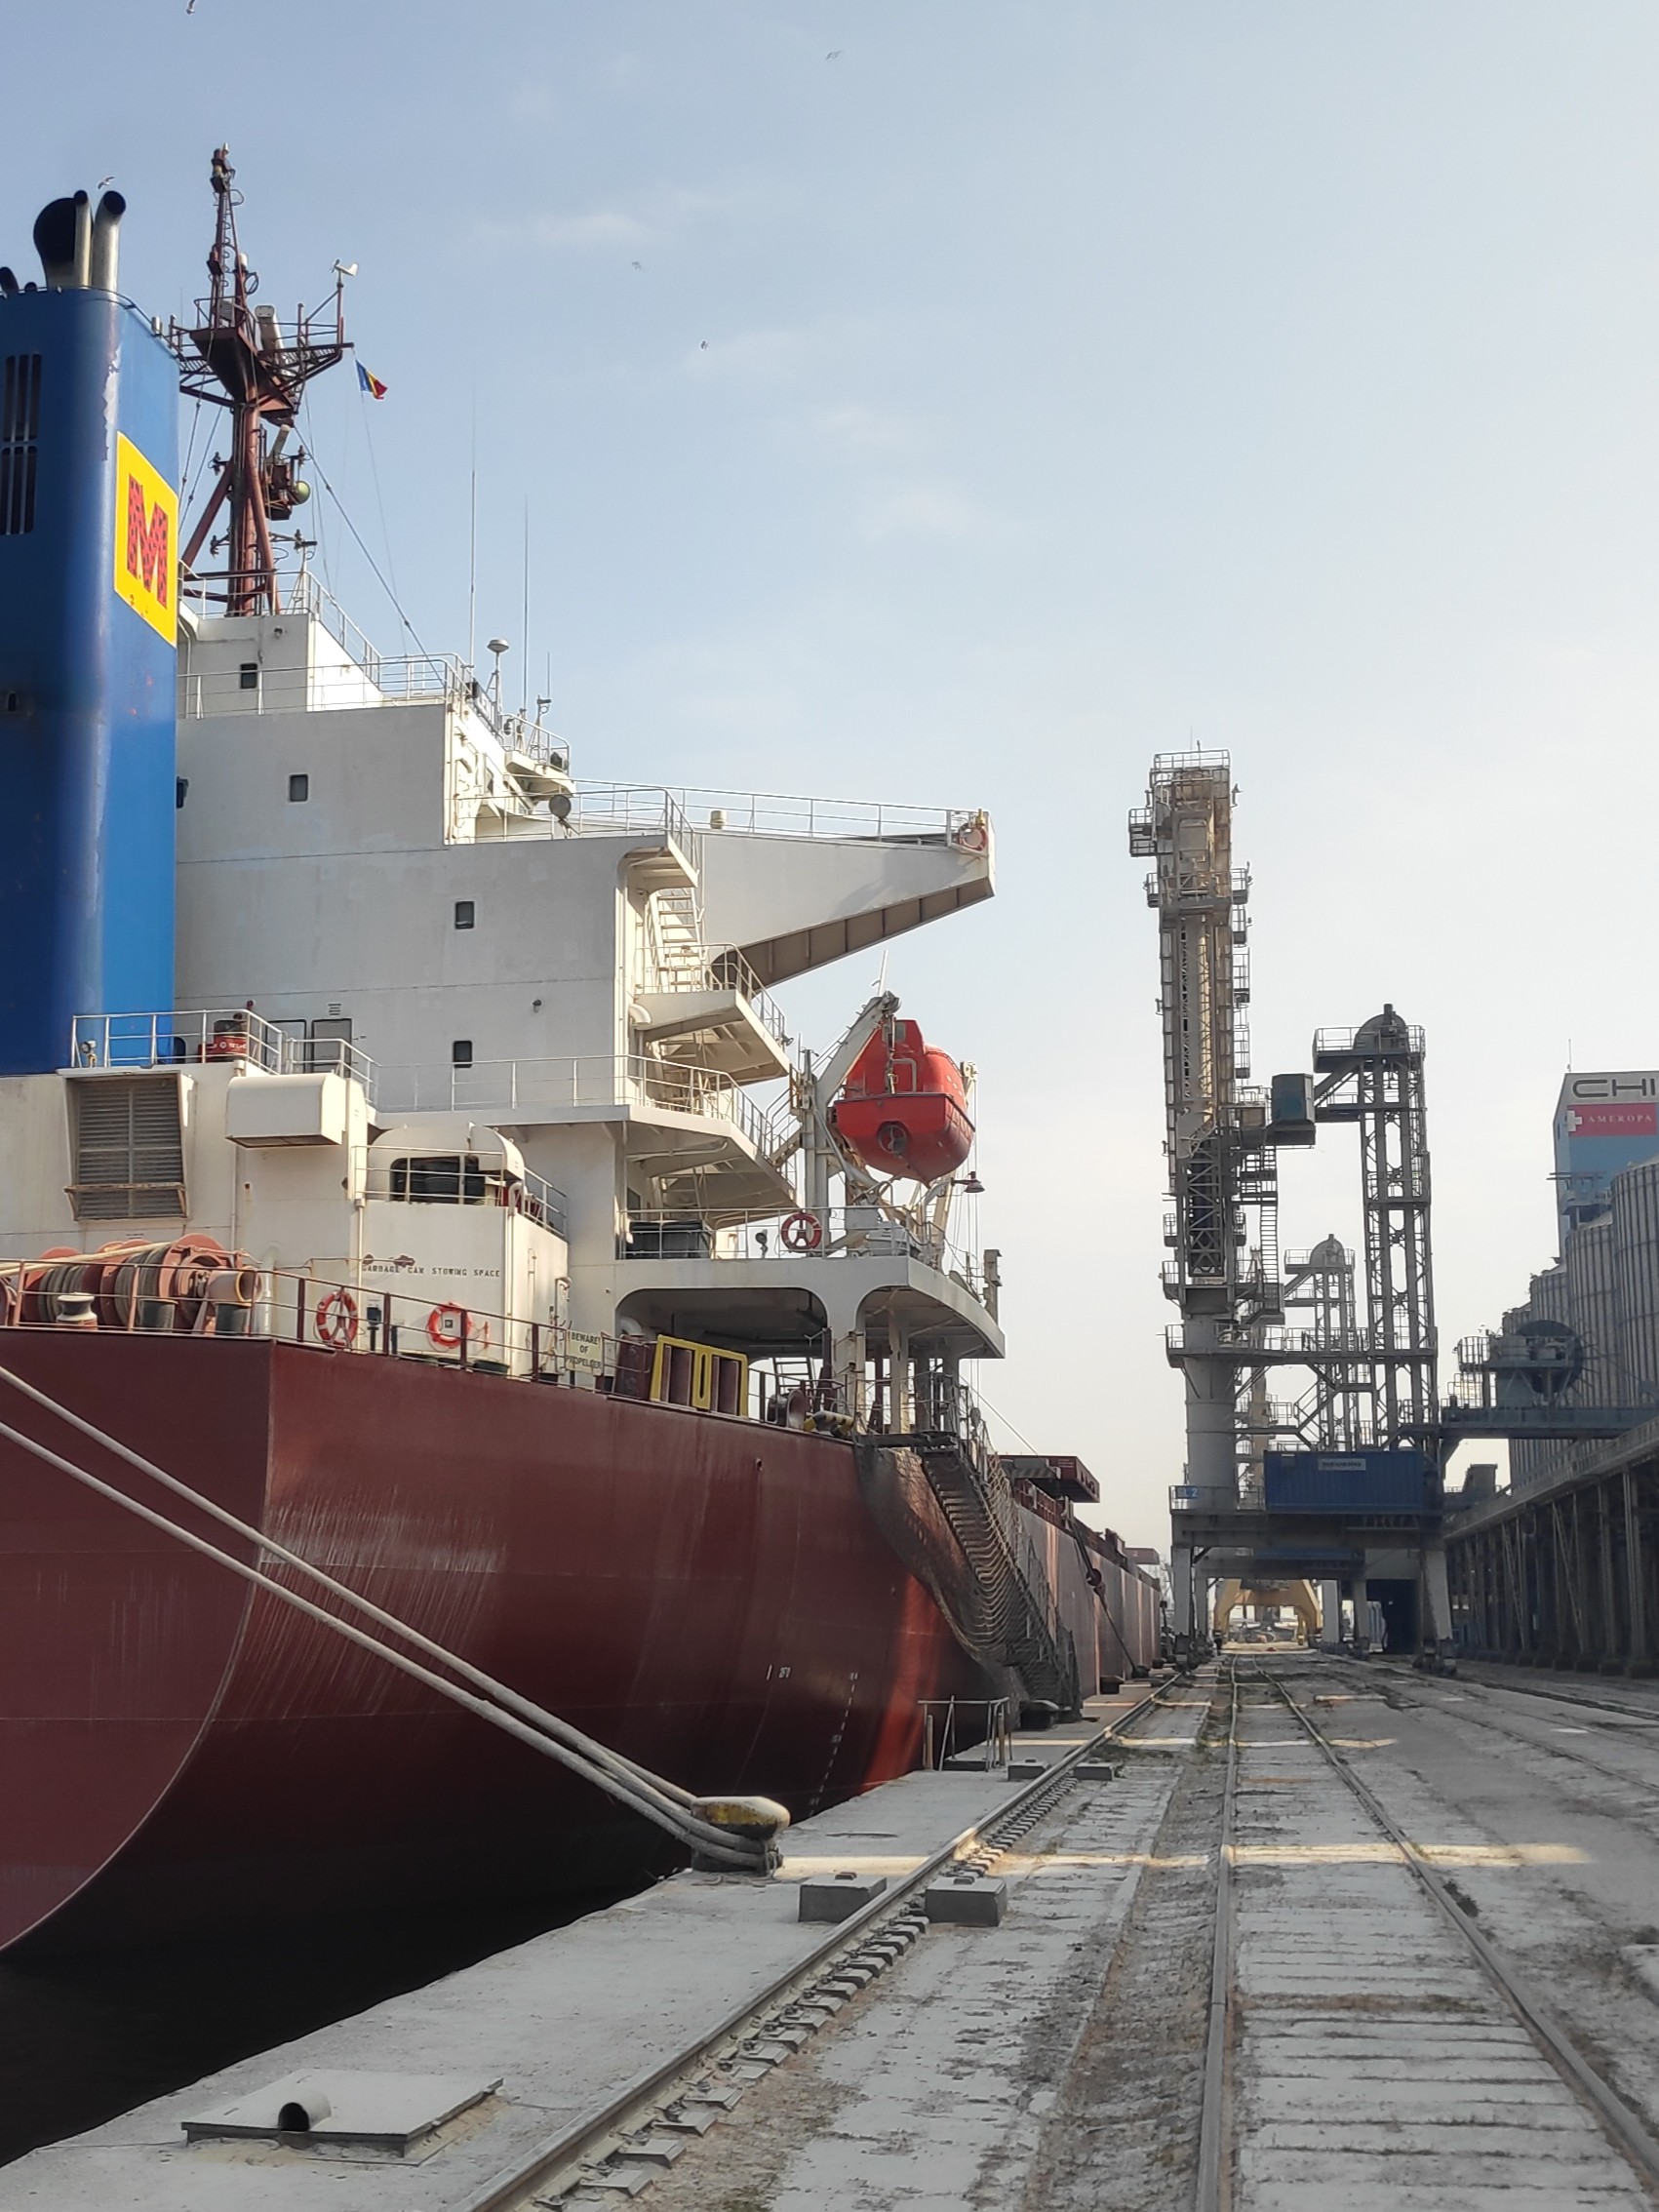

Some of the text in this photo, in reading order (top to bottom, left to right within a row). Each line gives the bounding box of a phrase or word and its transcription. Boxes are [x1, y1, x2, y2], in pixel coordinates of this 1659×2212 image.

[127, 473, 169, 611] M
[1572, 1078, 1656, 1098] CHI
[1588, 1114, 1653, 1124] AMEROPA
[407, 1266, 424, 1275] CAN
[431, 1267, 467, 1276] STOWING
[473, 1269, 500, 1278] SPACE
[571, 1331, 599, 1345] BEWARE
[579, 1344, 589, 1354] OF
